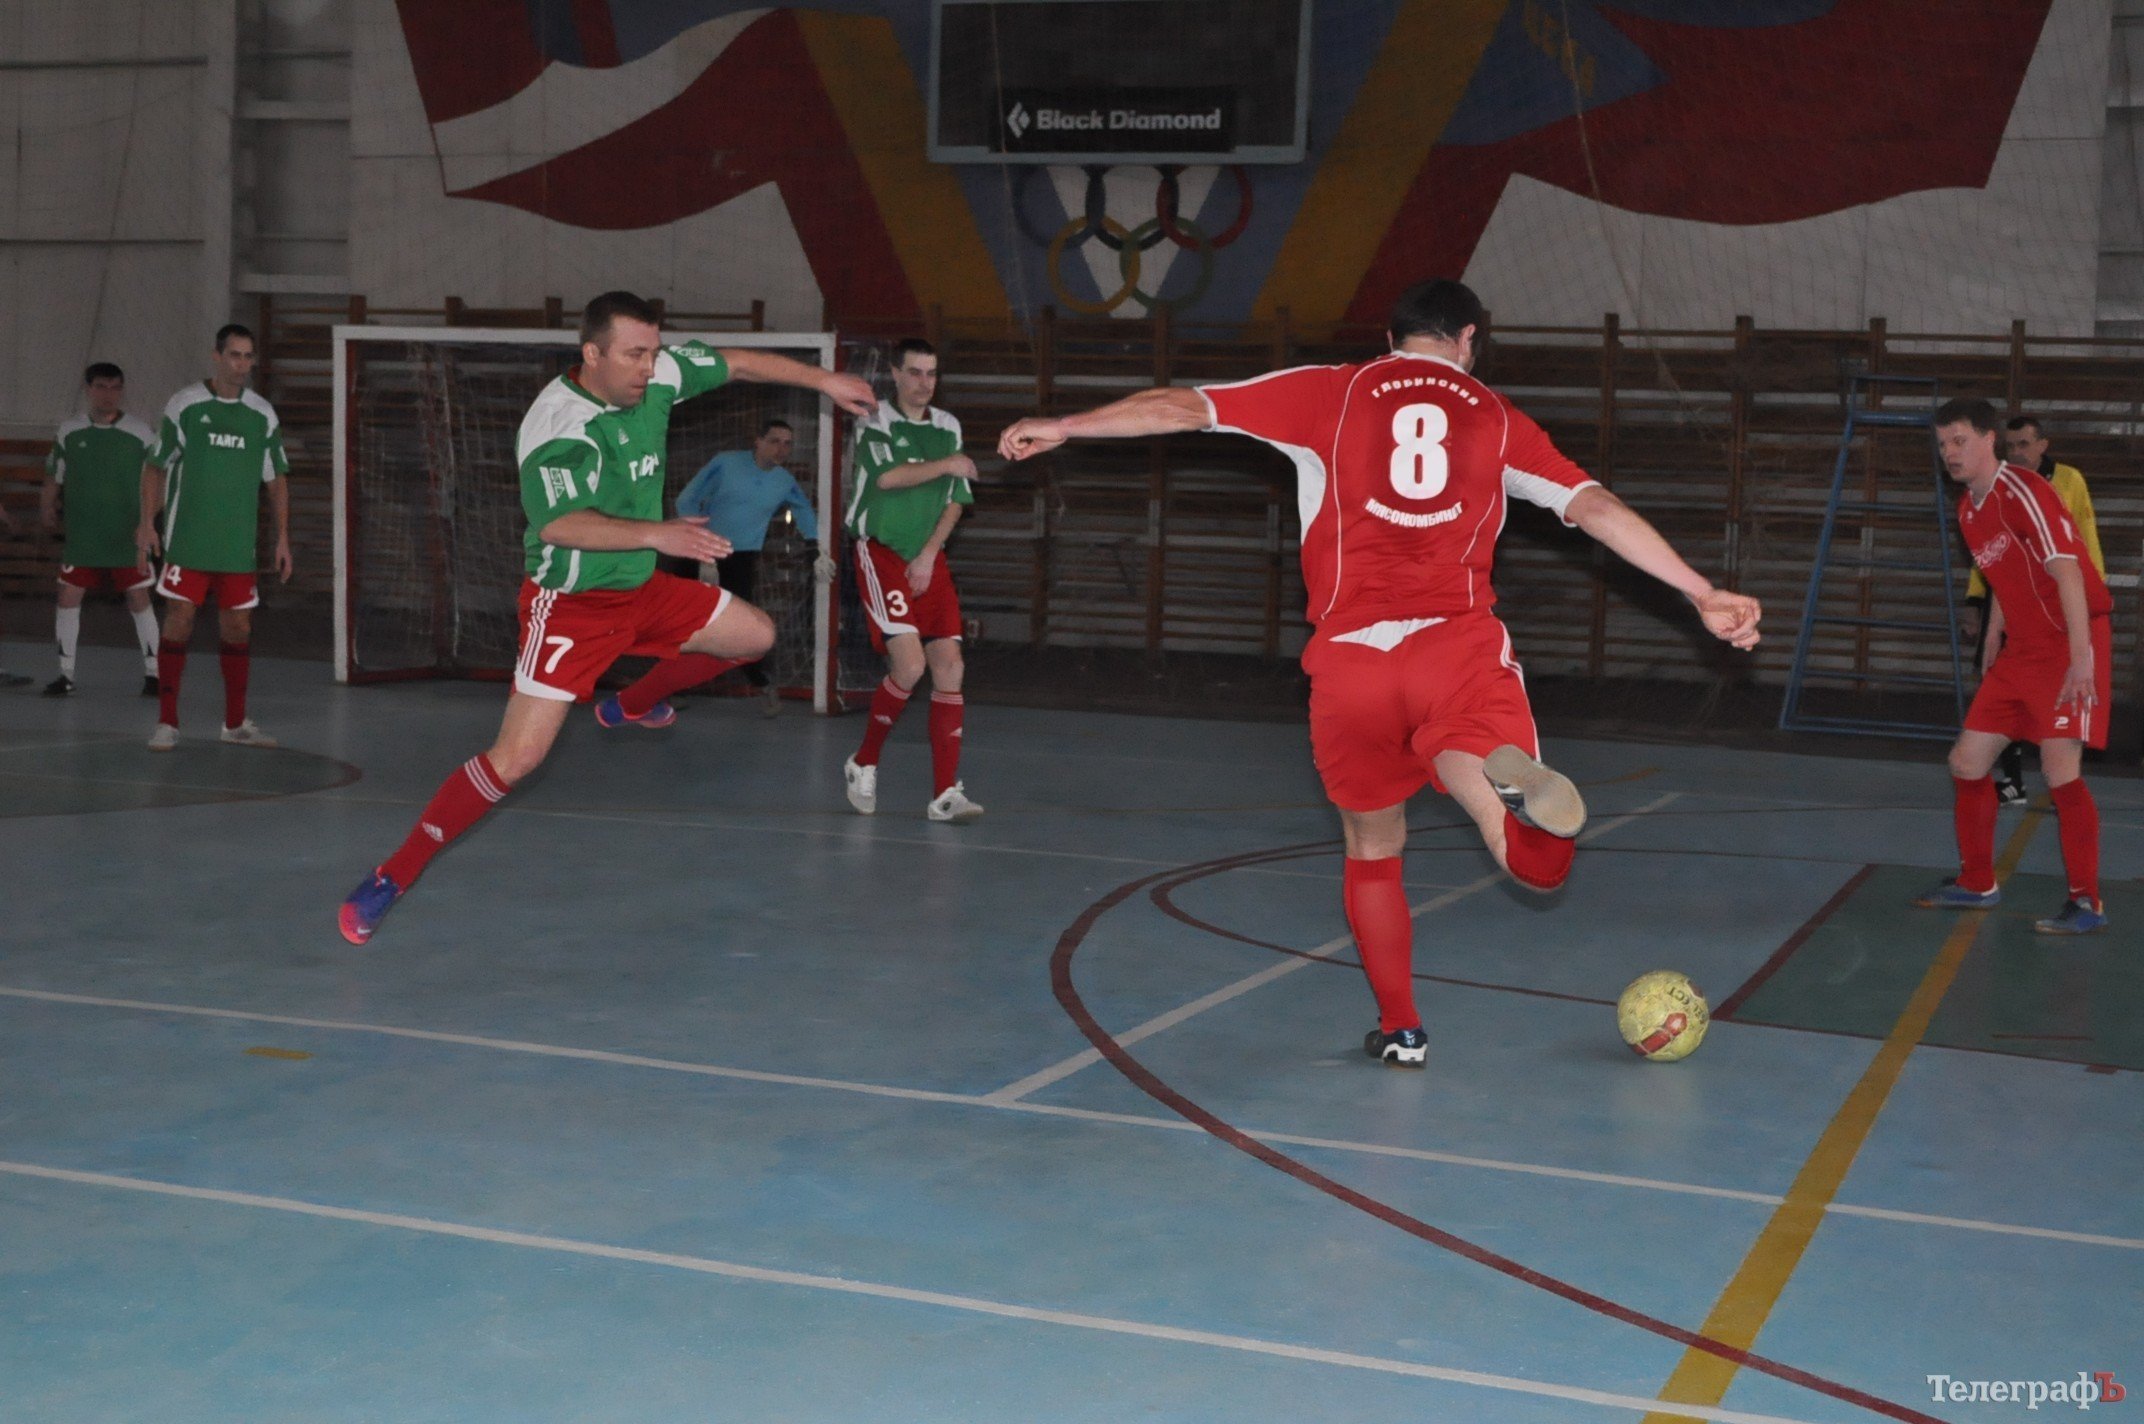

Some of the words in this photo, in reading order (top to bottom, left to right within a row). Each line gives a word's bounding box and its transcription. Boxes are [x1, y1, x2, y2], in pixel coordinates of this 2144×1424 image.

[1036, 109, 1103, 130] Black
[1109, 107, 1222, 130] Diamond
[1389, 403, 1449, 499] 8
[166, 564, 182, 586] 4
[886, 590, 909, 617] 3
[545, 636, 574, 674] 7
